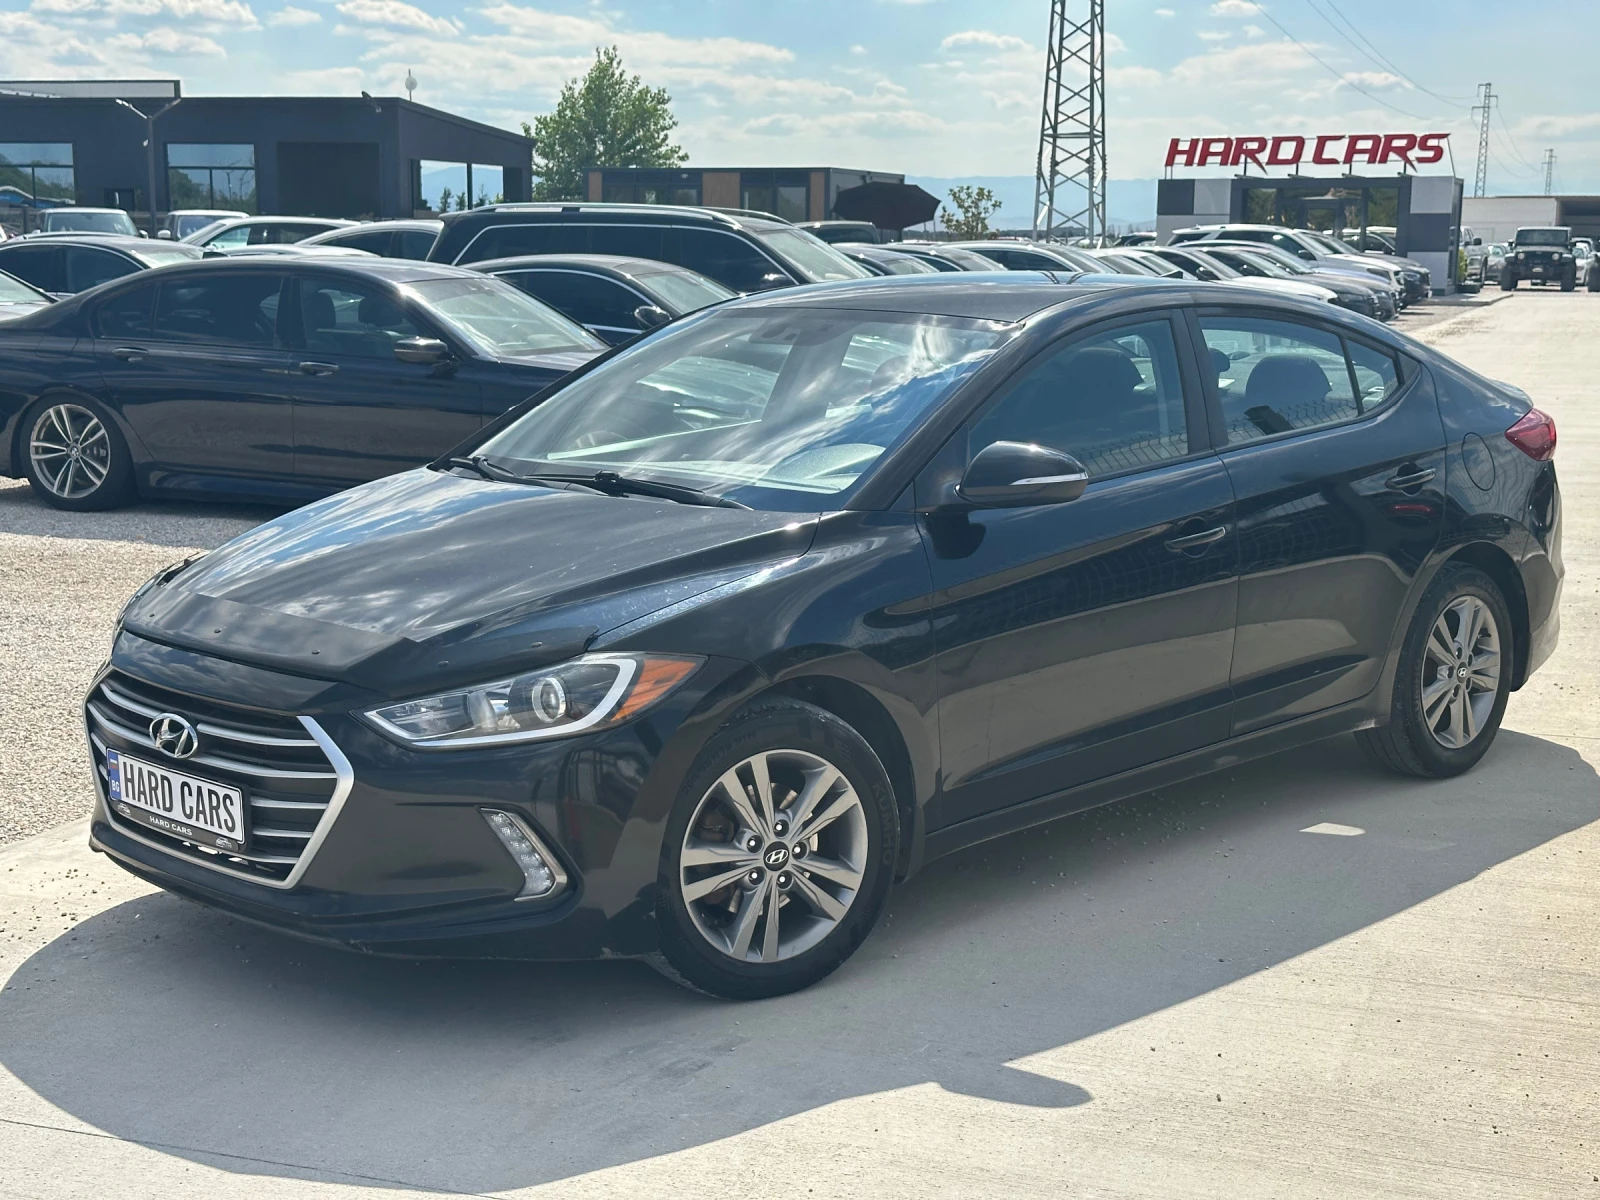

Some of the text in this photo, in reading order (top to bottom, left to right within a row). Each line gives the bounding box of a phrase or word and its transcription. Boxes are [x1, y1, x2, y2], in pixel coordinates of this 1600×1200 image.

[1164, 133, 1450, 175] HARD CARS
[111, 780, 120, 792] BG
[122, 761, 236, 833] HARD CARS
[149, 815, 193, 836] HARD CARS
